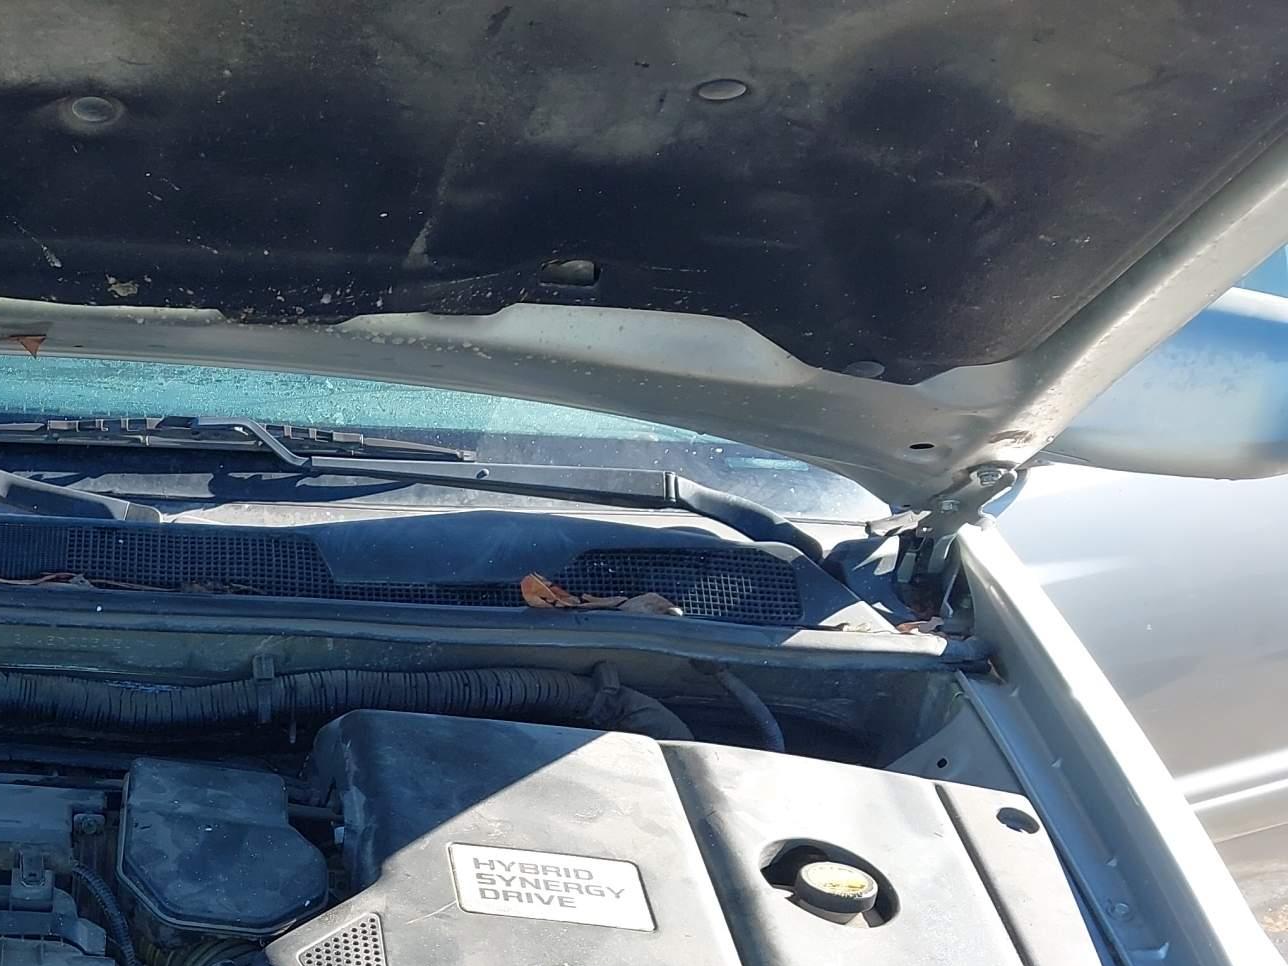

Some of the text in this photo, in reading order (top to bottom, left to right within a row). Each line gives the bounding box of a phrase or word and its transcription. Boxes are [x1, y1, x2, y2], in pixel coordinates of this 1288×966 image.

[472, 857, 594, 881] HYBRID
[475, 872, 626, 899] SYNERGY
[478, 887, 577, 909] DRIVE
